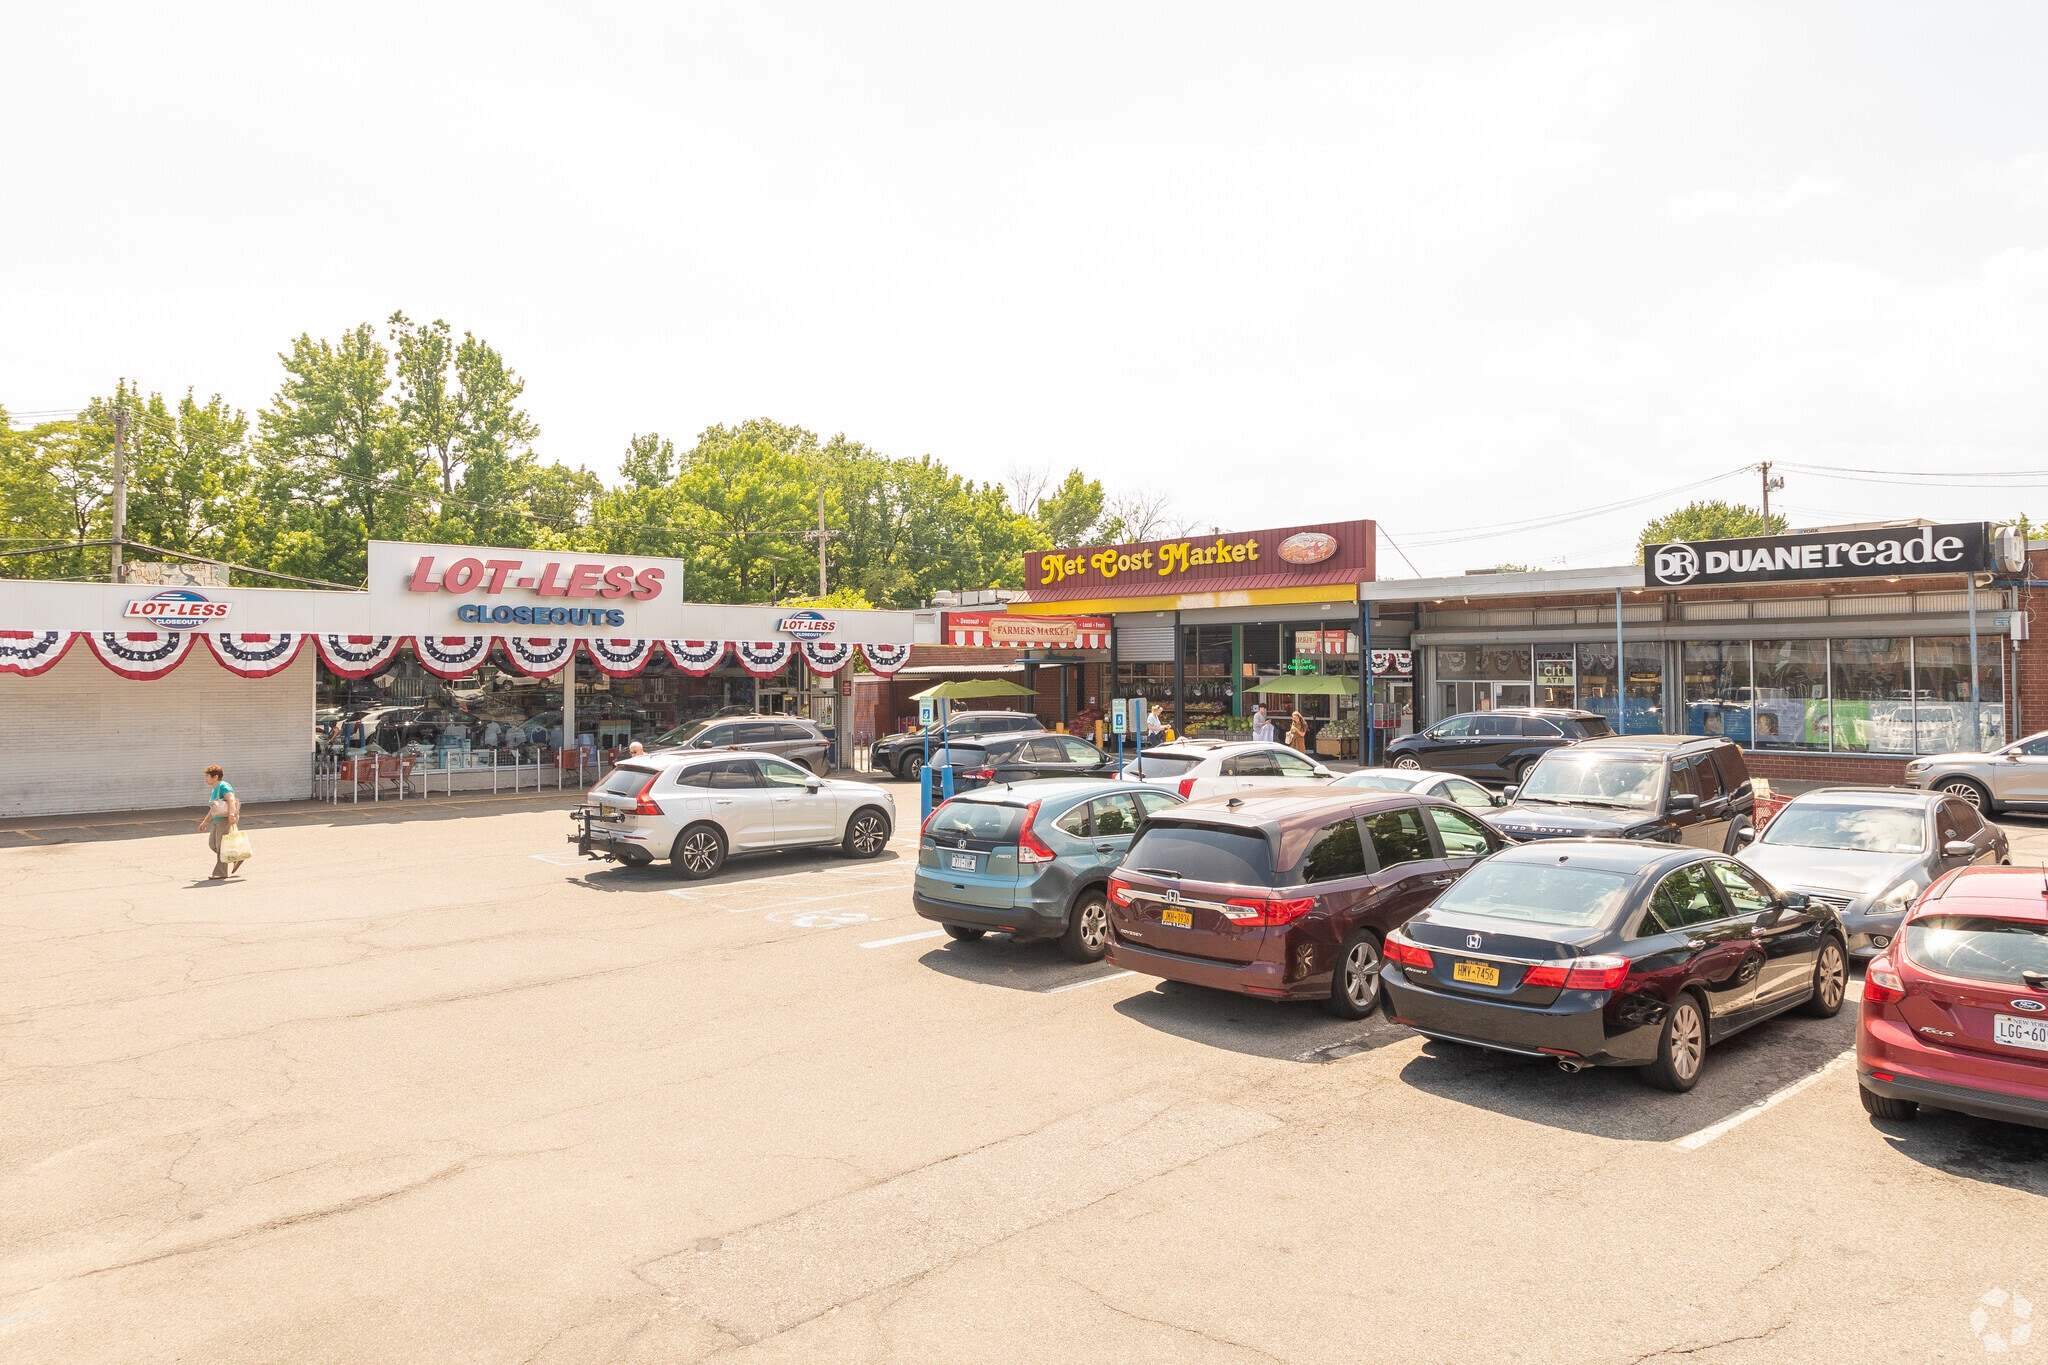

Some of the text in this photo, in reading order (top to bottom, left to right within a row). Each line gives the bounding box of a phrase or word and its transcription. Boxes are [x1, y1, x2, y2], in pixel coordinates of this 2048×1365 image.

[1040, 538, 1259, 585] Net Cost Market
[408, 556, 666, 601] LOT-LESS
[129, 602, 228, 616] LOT-LESS
[457, 604, 625, 628] CLOSEOUTS
[156, 618, 204, 626] CLOSEOUTS
[782, 620, 836, 631] LOT-LESS
[997, 625, 1070, 636] FARMERS MARKET
[1544, 664, 1566, 676] citi
[1120, 928, 1143, 937] ODYSSEY
[1404, 967, 1428, 975] Accord
[1920, 1027, 1955, 1037] Focus
